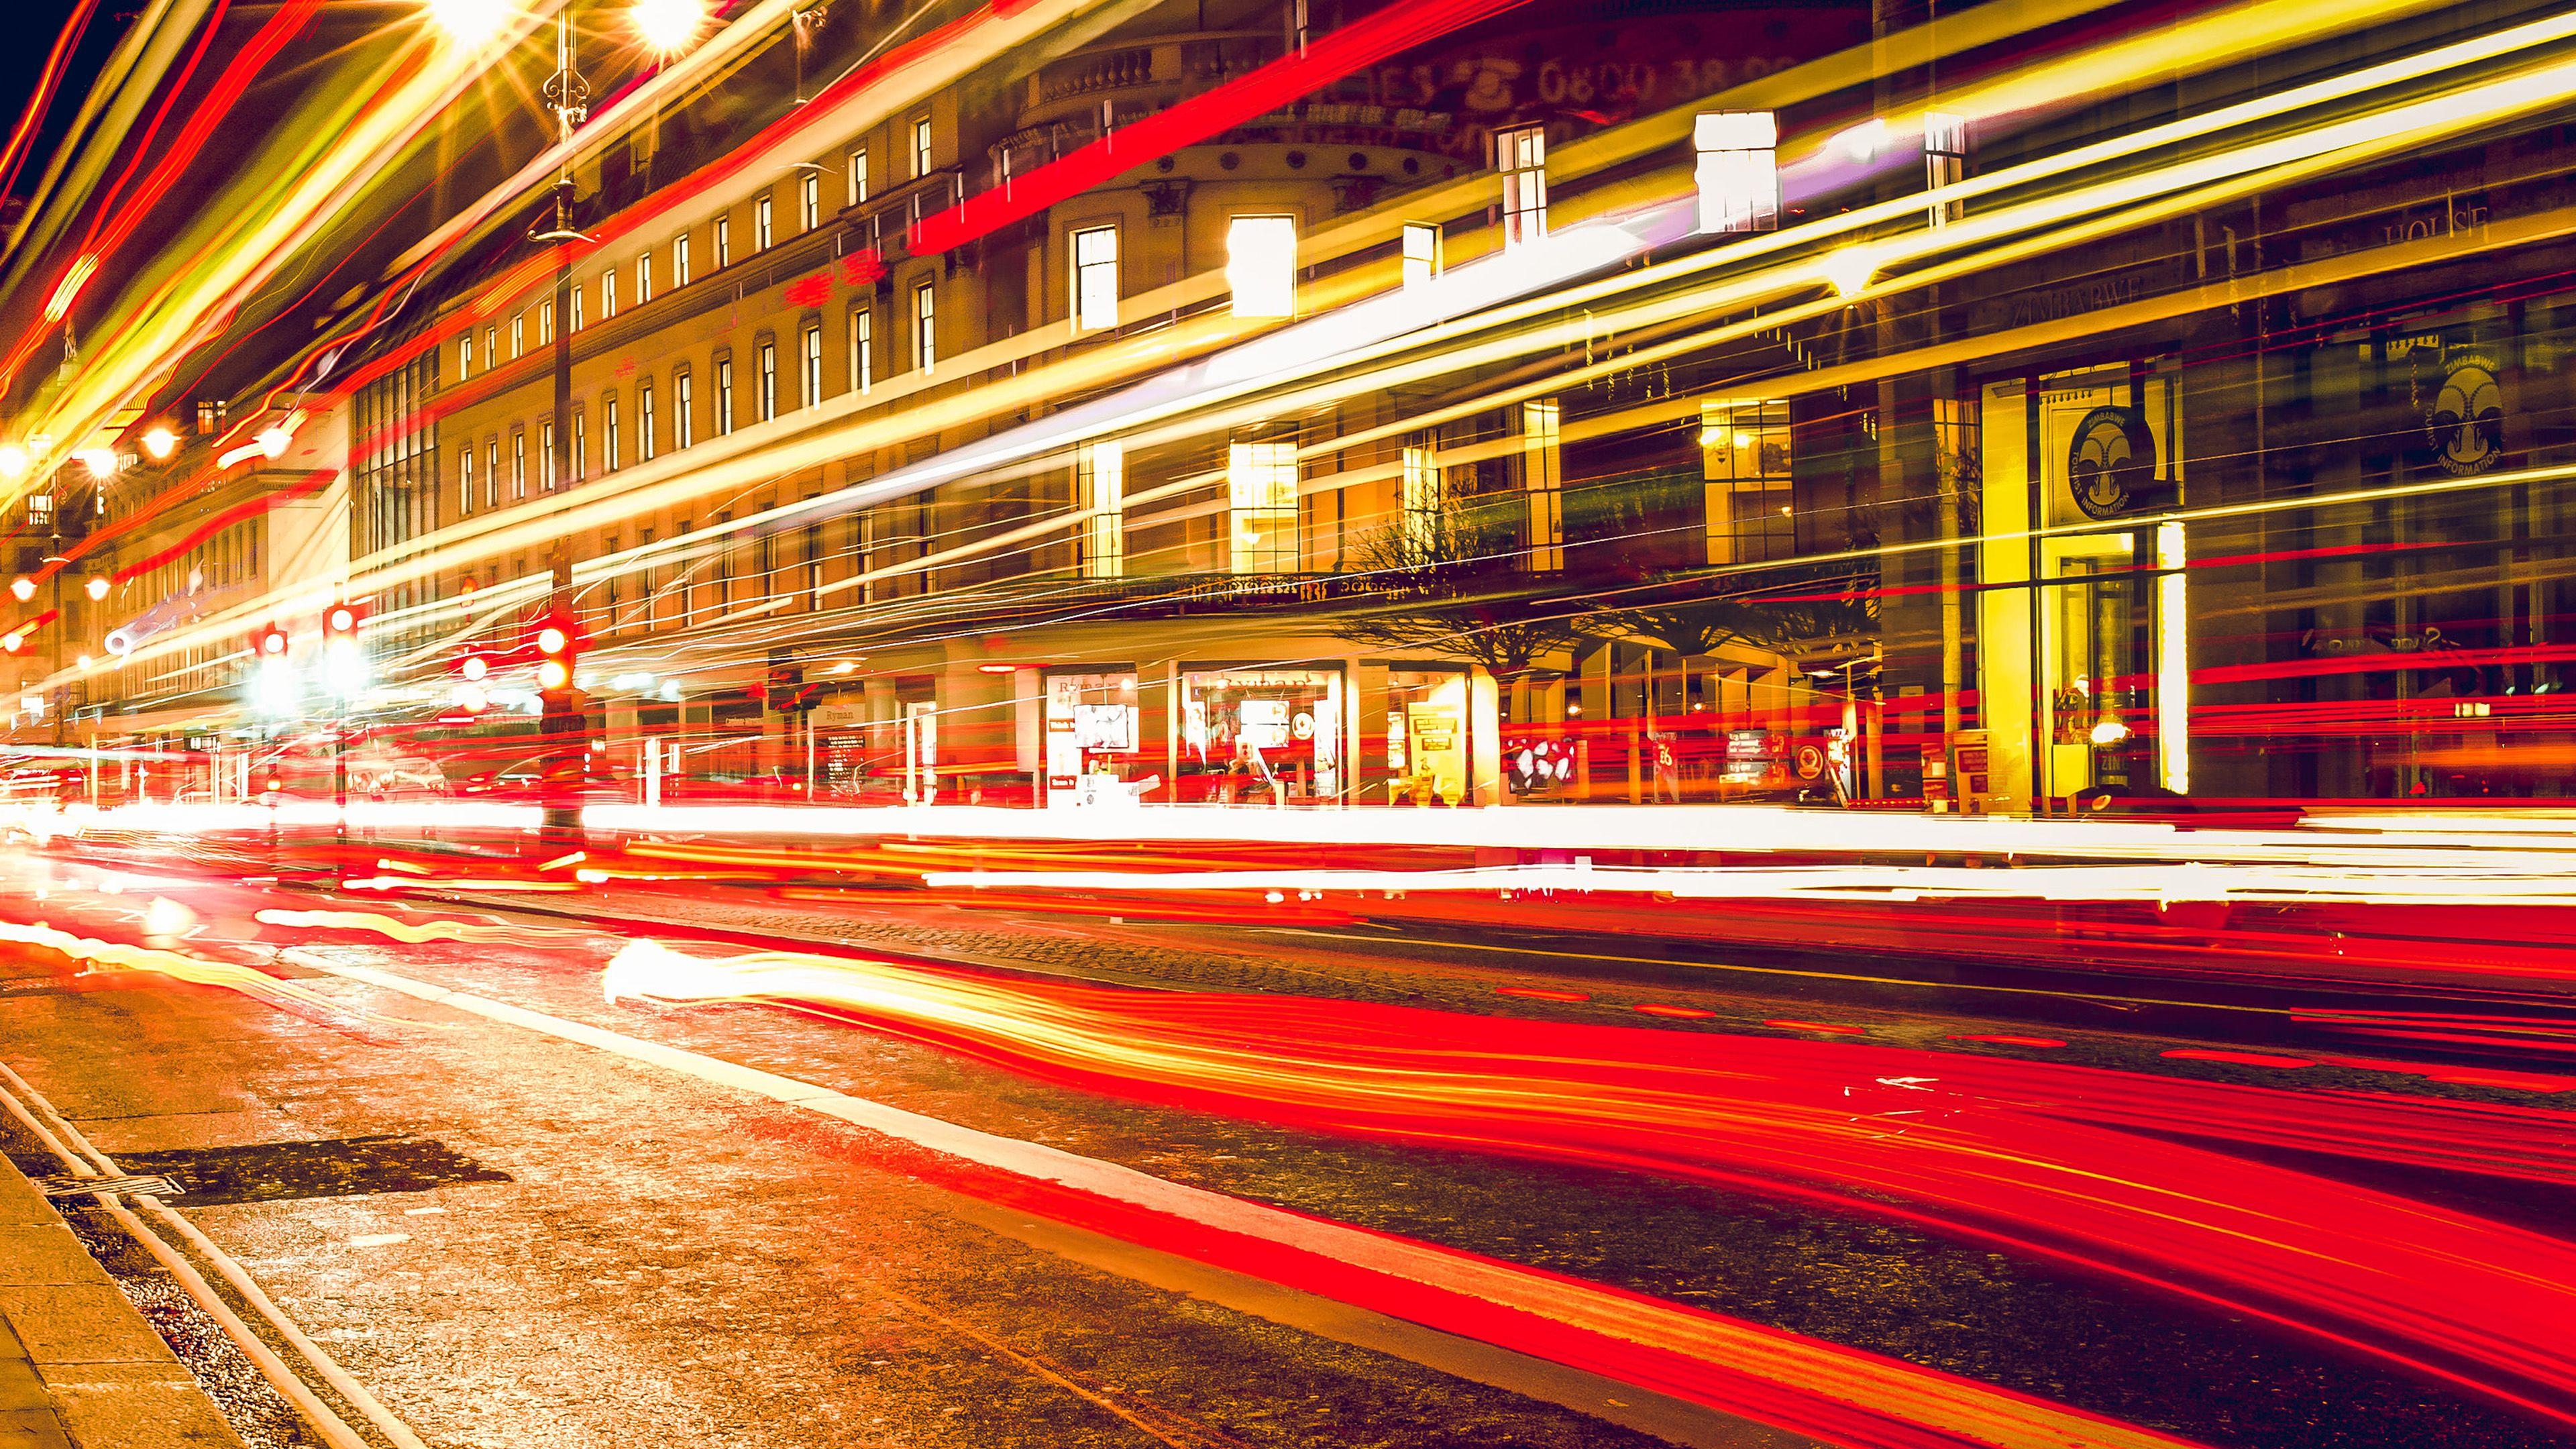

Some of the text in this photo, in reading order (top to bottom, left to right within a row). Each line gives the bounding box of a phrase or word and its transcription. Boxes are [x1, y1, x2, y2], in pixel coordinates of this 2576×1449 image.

[2445, 354, 2496, 375] ZIMBABWE
[2087, 411, 2126, 429] ZIMBABWE
[2437, 446, 2502, 476] INFORMATION
[2081, 492, 2130, 516] INFORMATION
[826, 710, 854, 721] Ryman
